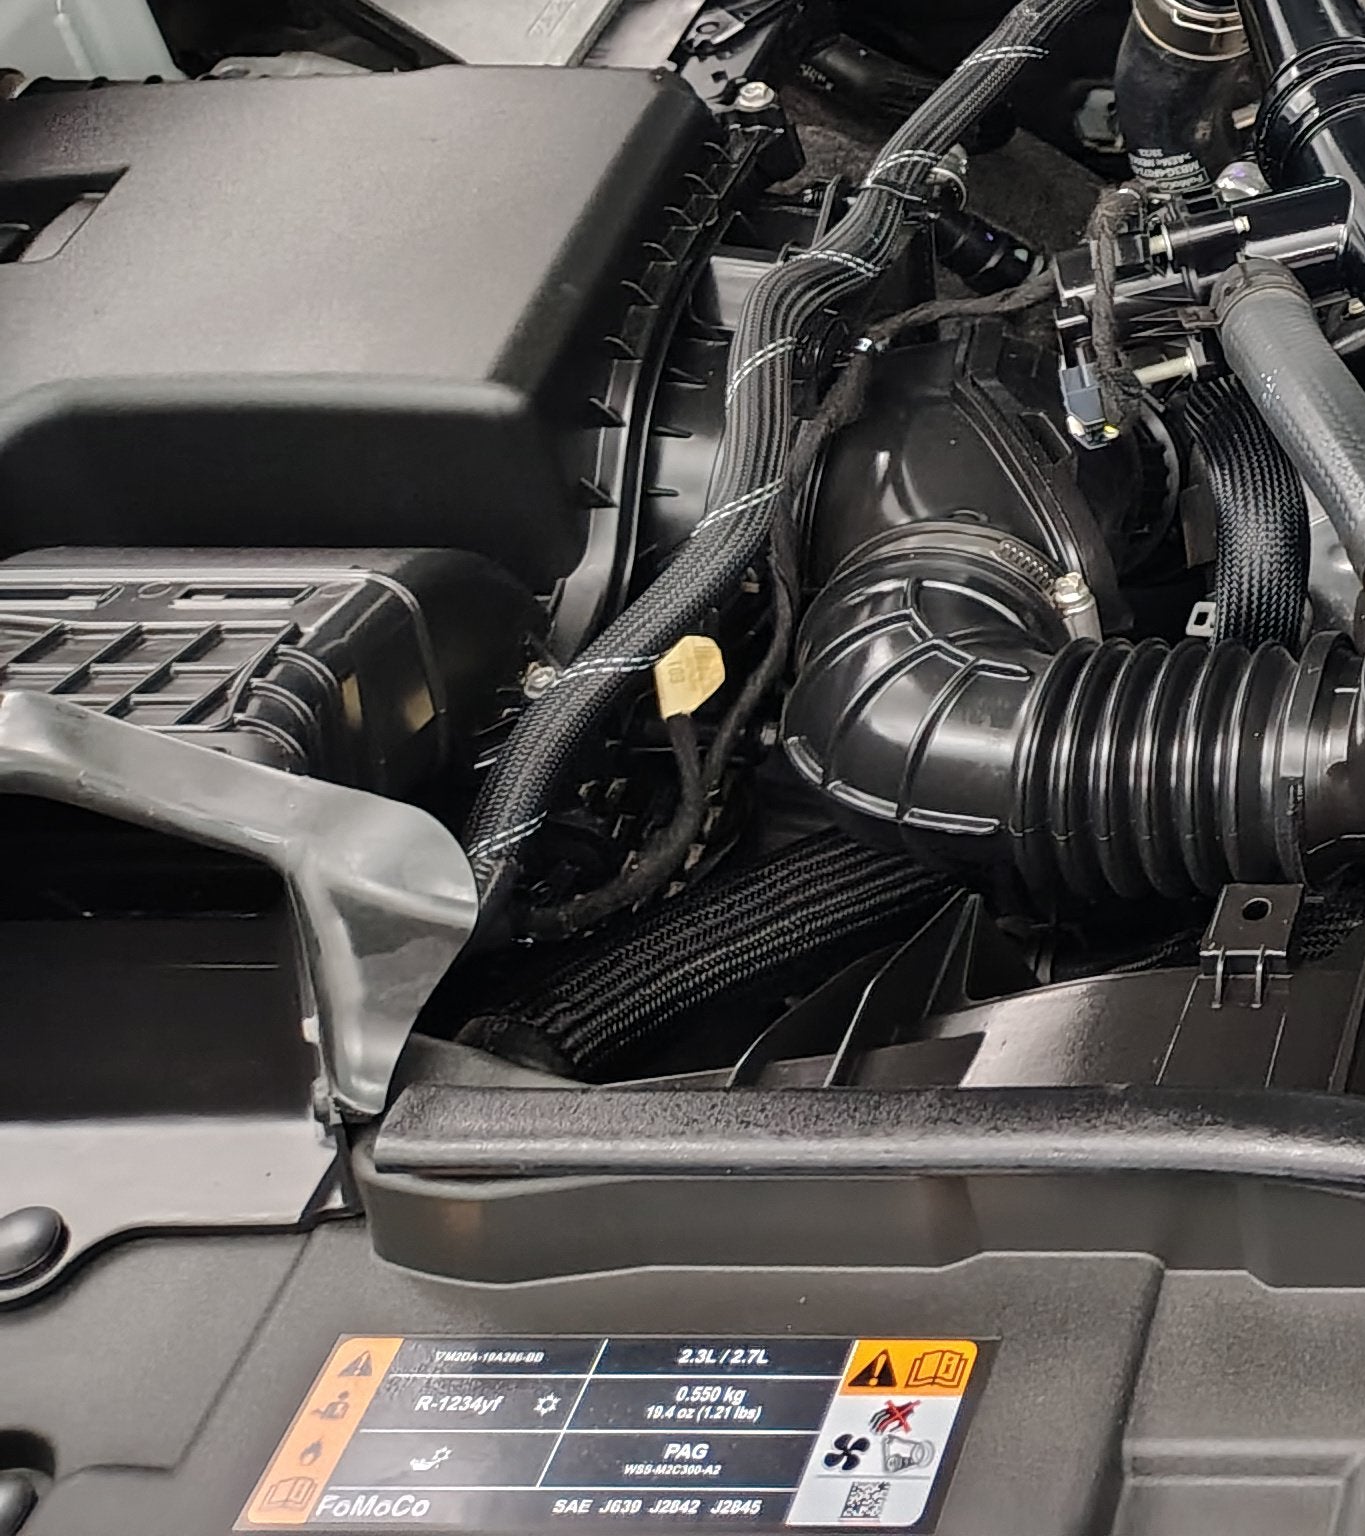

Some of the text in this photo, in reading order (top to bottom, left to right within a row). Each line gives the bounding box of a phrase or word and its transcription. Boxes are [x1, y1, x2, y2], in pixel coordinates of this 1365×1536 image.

[677, 1348, 717, 1365] 2.3L
[730, 1348, 770, 1365] 2.7L
[414, 1395, 505, 1416] R-1234yf
[675, 1386, 748, 1406] 0.550 kg
[646, 1405, 763, 1424] 19.4 oz (1.21 lbs)
[663, 1443, 710, 1460] PAG
[314, 1494, 431, 1518] FoMoCo
[551, 1498, 595, 1514] SAE
